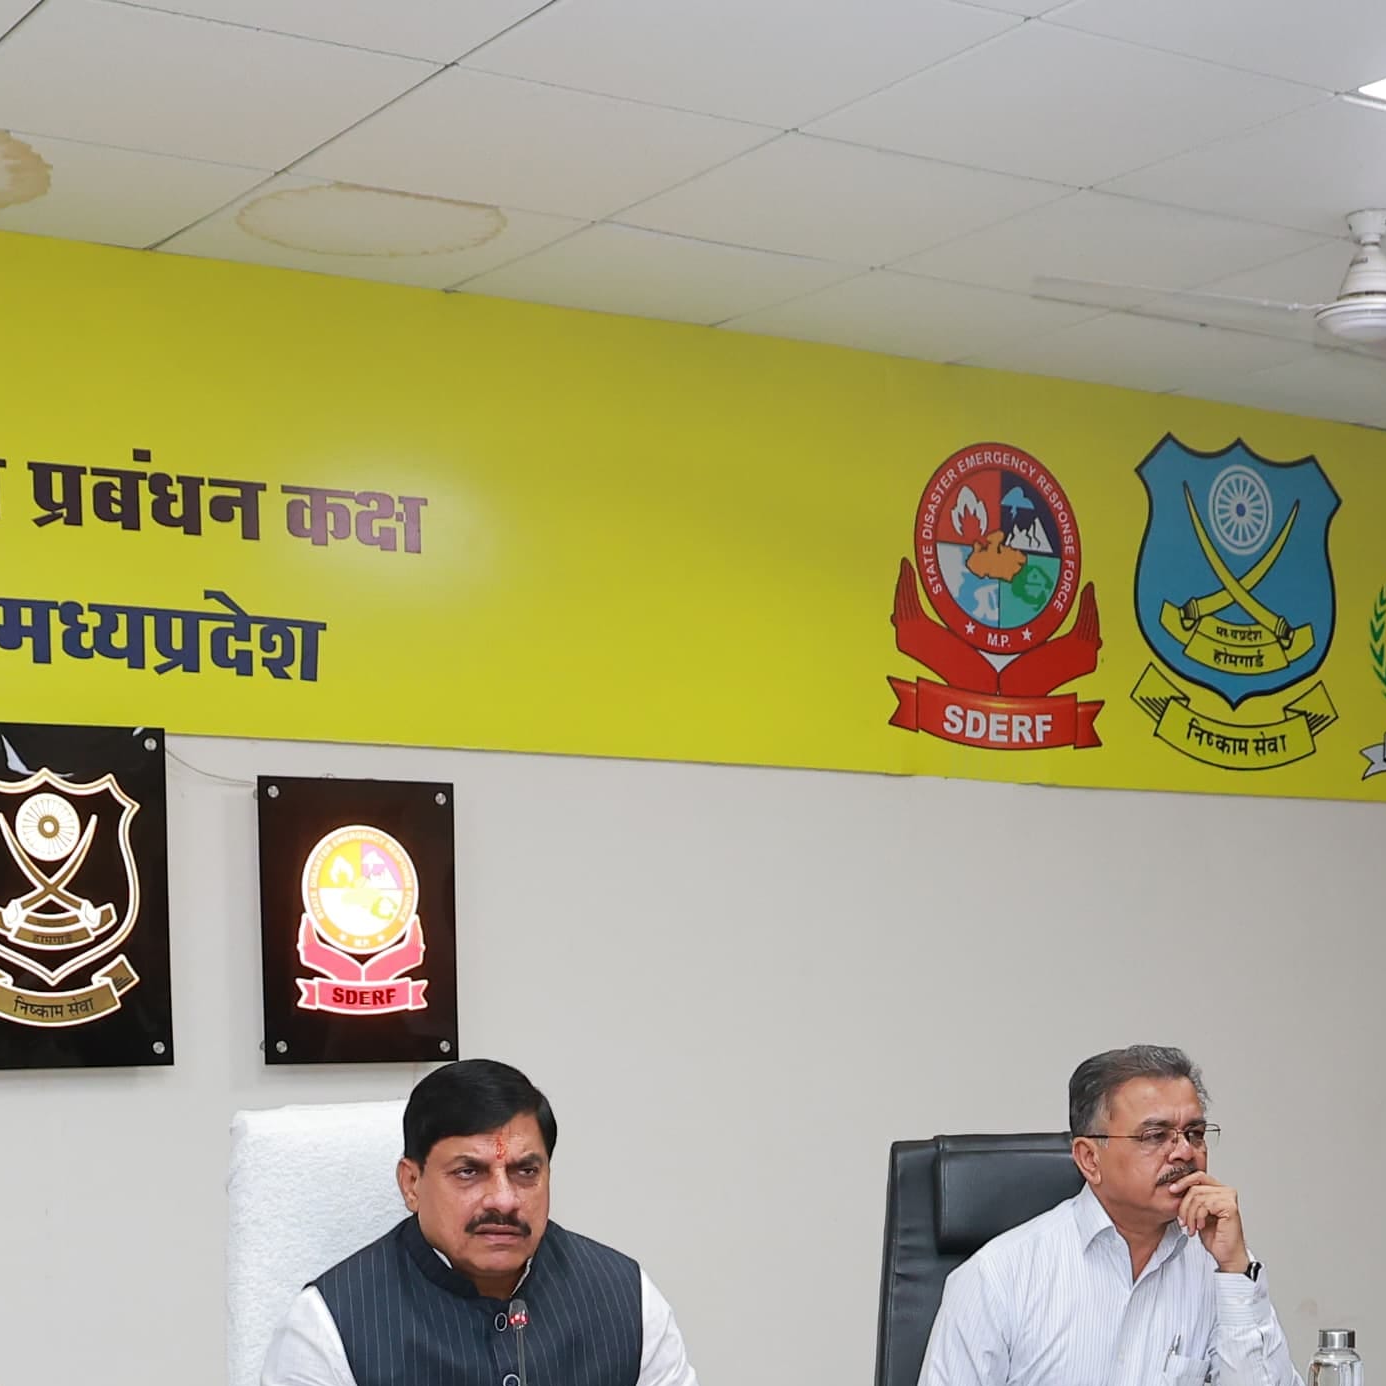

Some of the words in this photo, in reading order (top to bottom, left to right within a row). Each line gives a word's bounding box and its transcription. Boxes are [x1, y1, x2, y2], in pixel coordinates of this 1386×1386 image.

[956, 450, 1037, 477] EMERGENCY
[27, 448, 266, 541] प्रबंधन
[281, 484, 428, 554] कक्ष
[922, 468, 958, 541] DISASTER
[1036, 474, 1075, 555] RESPONSE
[922, 545, 942, 594] STATE
[1053, 559, 1075, 612] FORCE
[987, 632, 1011, 648] M.P.
[943, 704, 1053, 743] SDERF
[1186, 717, 1249, 755] निष्काम
[1252, 731, 1287, 756] सेवा
[13, 995, 63, 1018] निष्काम
[68, 997, 94, 1017] सेवा
[332, 987, 397, 1006] SDERF
